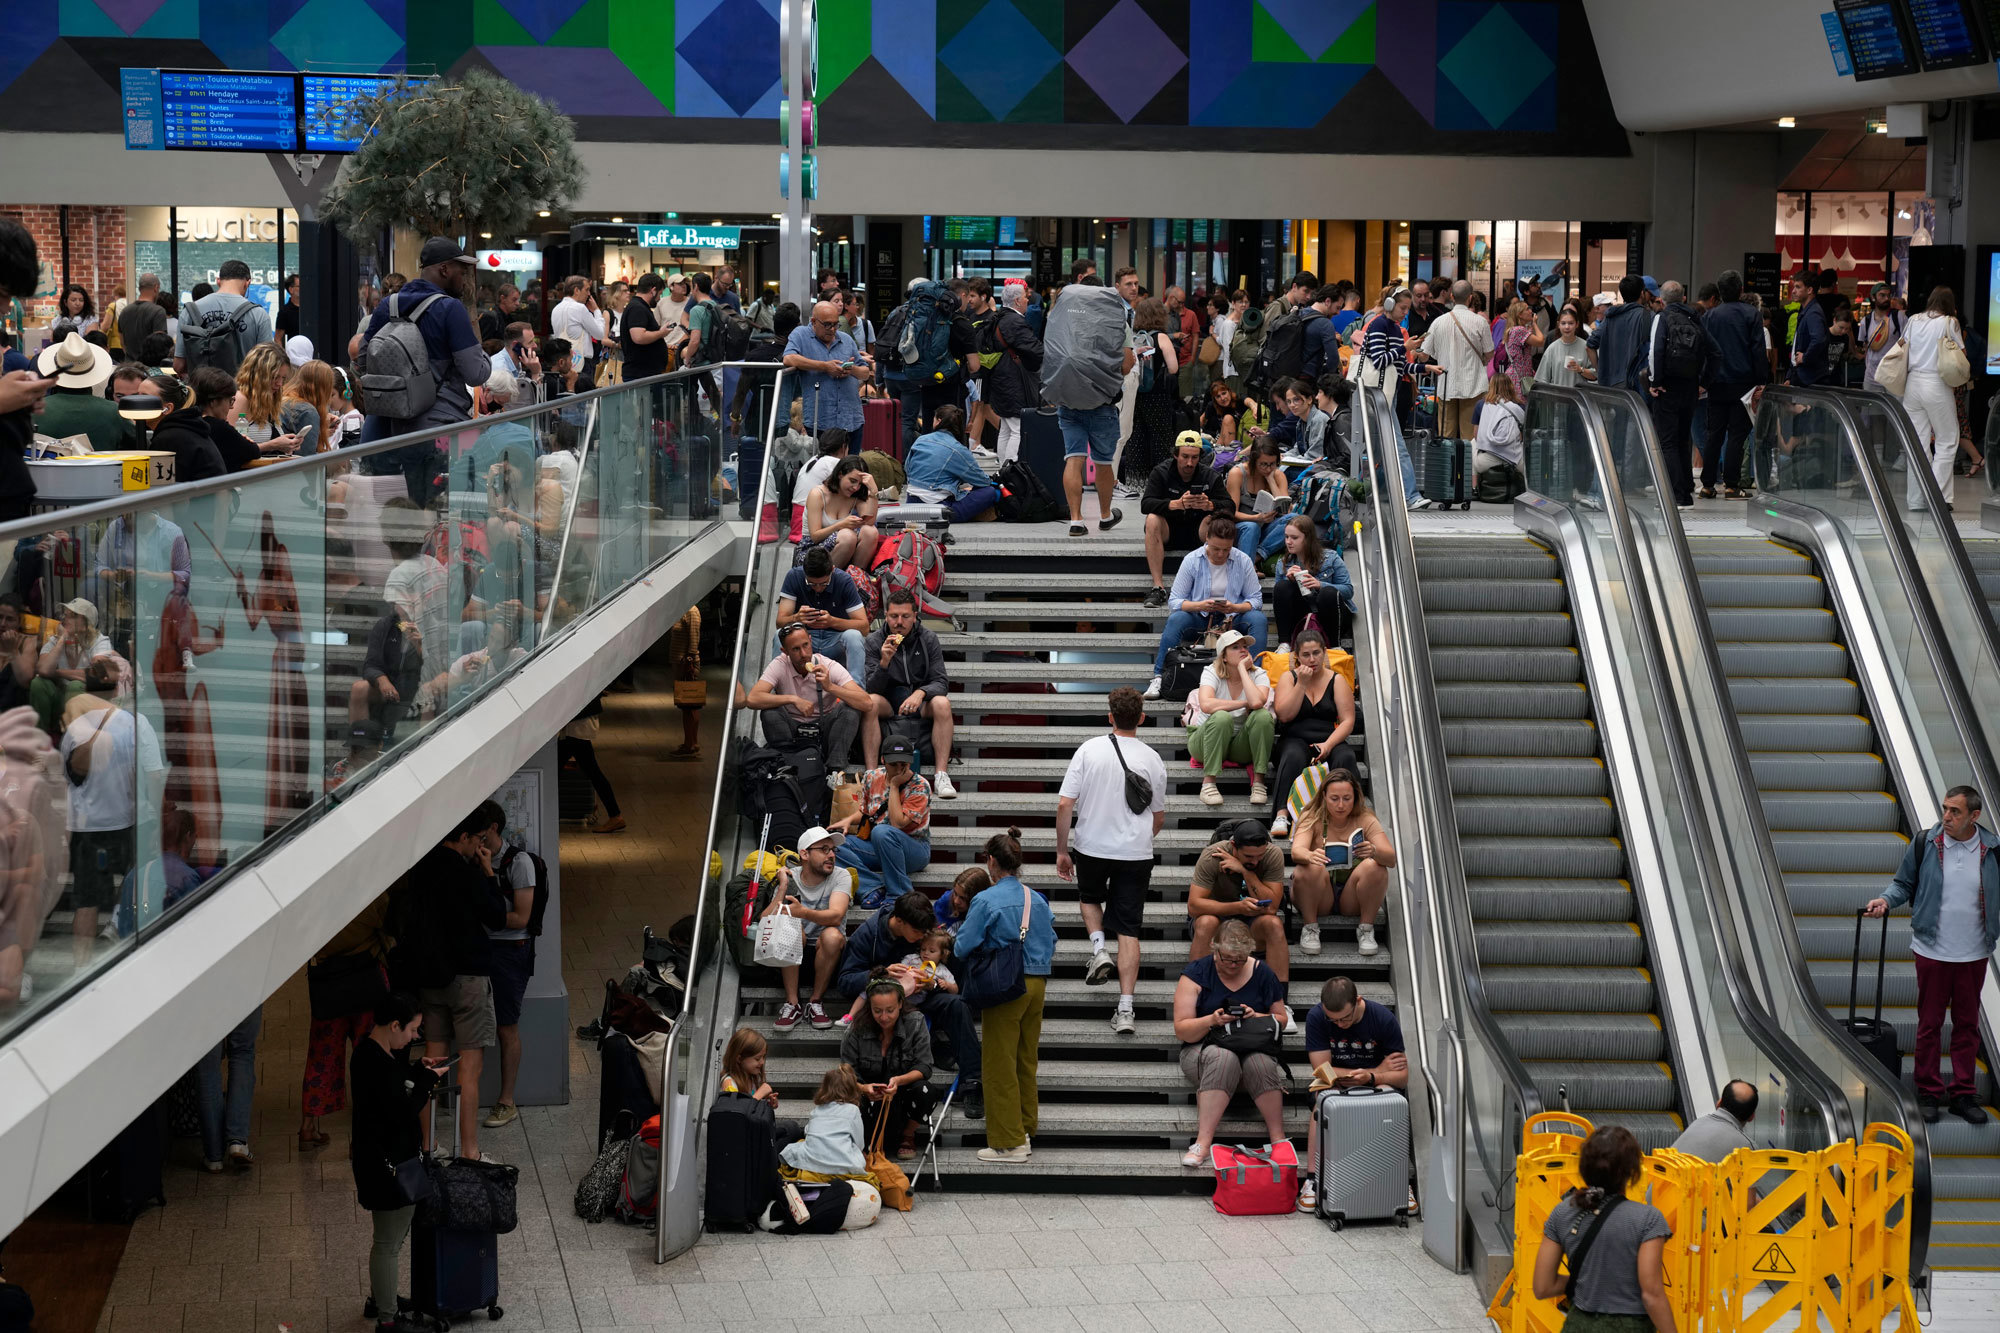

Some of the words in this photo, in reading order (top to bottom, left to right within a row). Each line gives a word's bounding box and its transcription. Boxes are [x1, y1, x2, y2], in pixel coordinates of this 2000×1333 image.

[208, 90, 239, 98] Hendaye
[276, 88, 290, 150] départs
[168, 212, 299, 242] swatch
[640, 230, 669, 247] Jeff
[670, 234, 682, 244] de
[684, 228, 737, 248] Bruges
[504, 256, 532, 264] selecta
